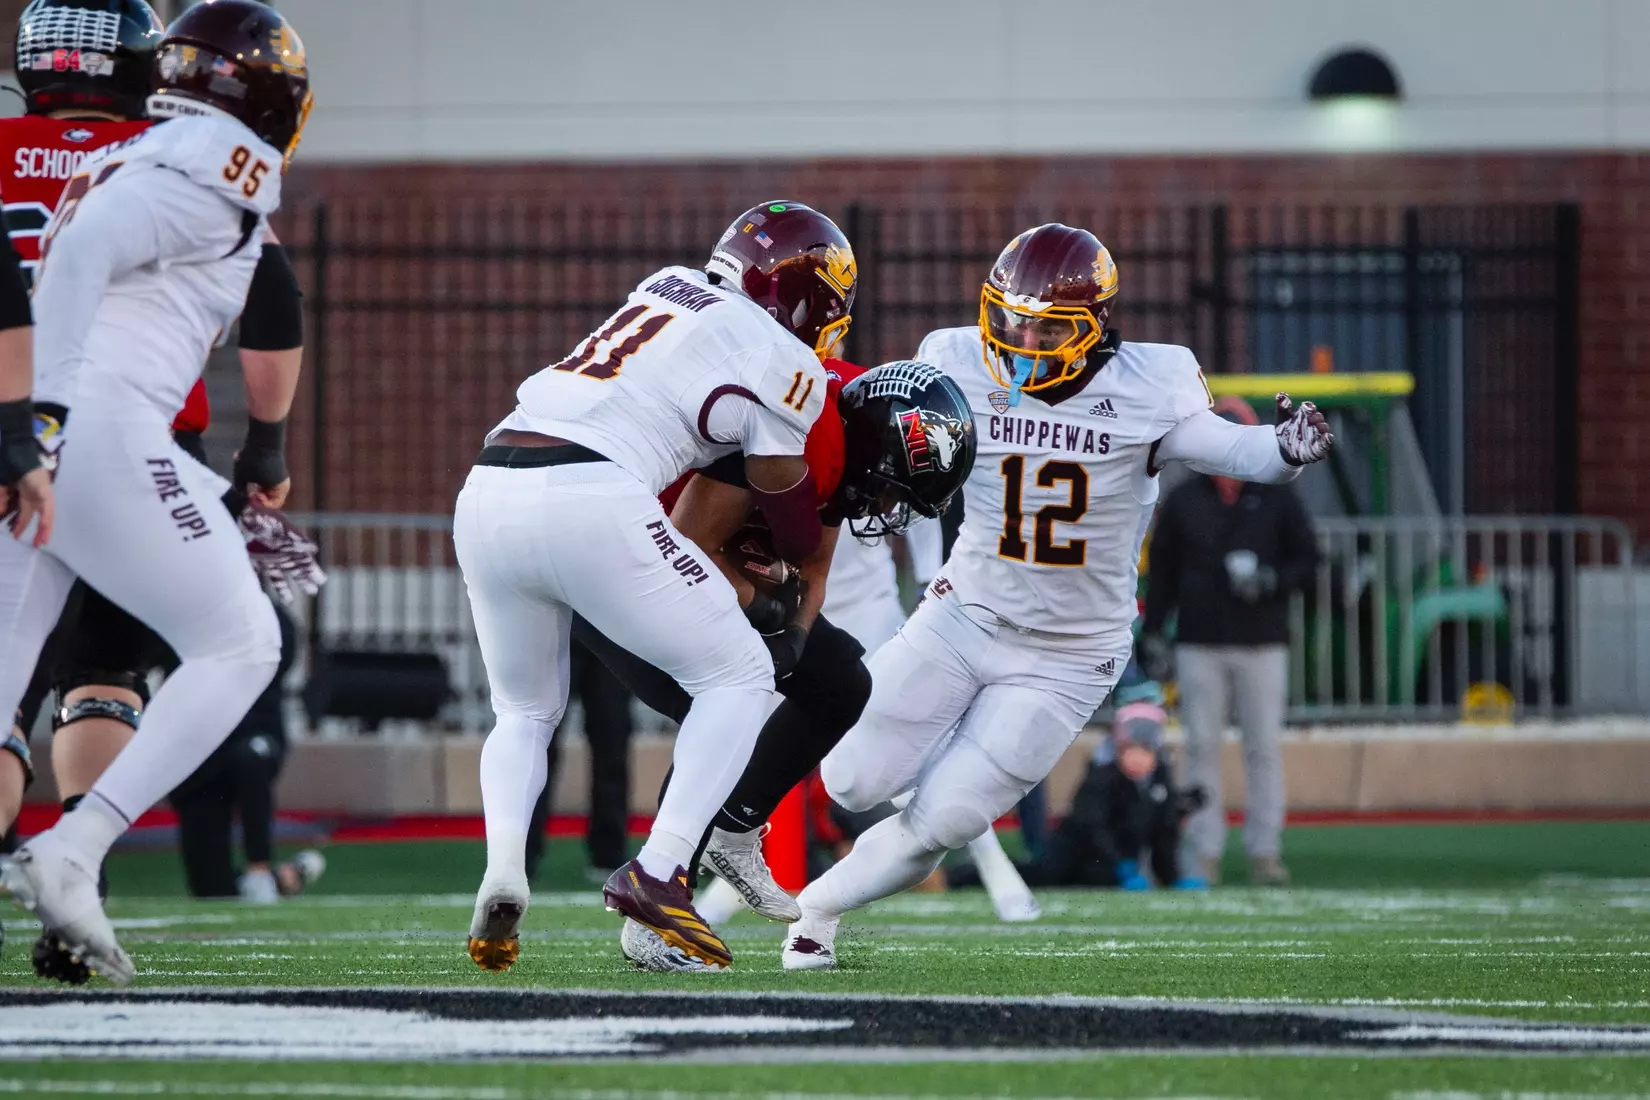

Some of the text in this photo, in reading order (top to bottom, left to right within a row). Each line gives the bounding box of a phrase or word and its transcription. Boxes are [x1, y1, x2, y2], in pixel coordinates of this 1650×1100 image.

[222, 145, 270, 198] 95
[645, 275, 726, 312] COCHRAN
[552, 304, 676, 381] 11
[783, 370, 815, 413] 11
[1088, 408, 1118, 419] adidas
[900, 410, 931, 471] NIU
[990, 415, 1111, 455] CHIPPEWAS
[146, 457, 212, 542] FIRE UP!
[998, 453, 1090, 567] 12
[646, 520, 710, 587] FIRE UP!
